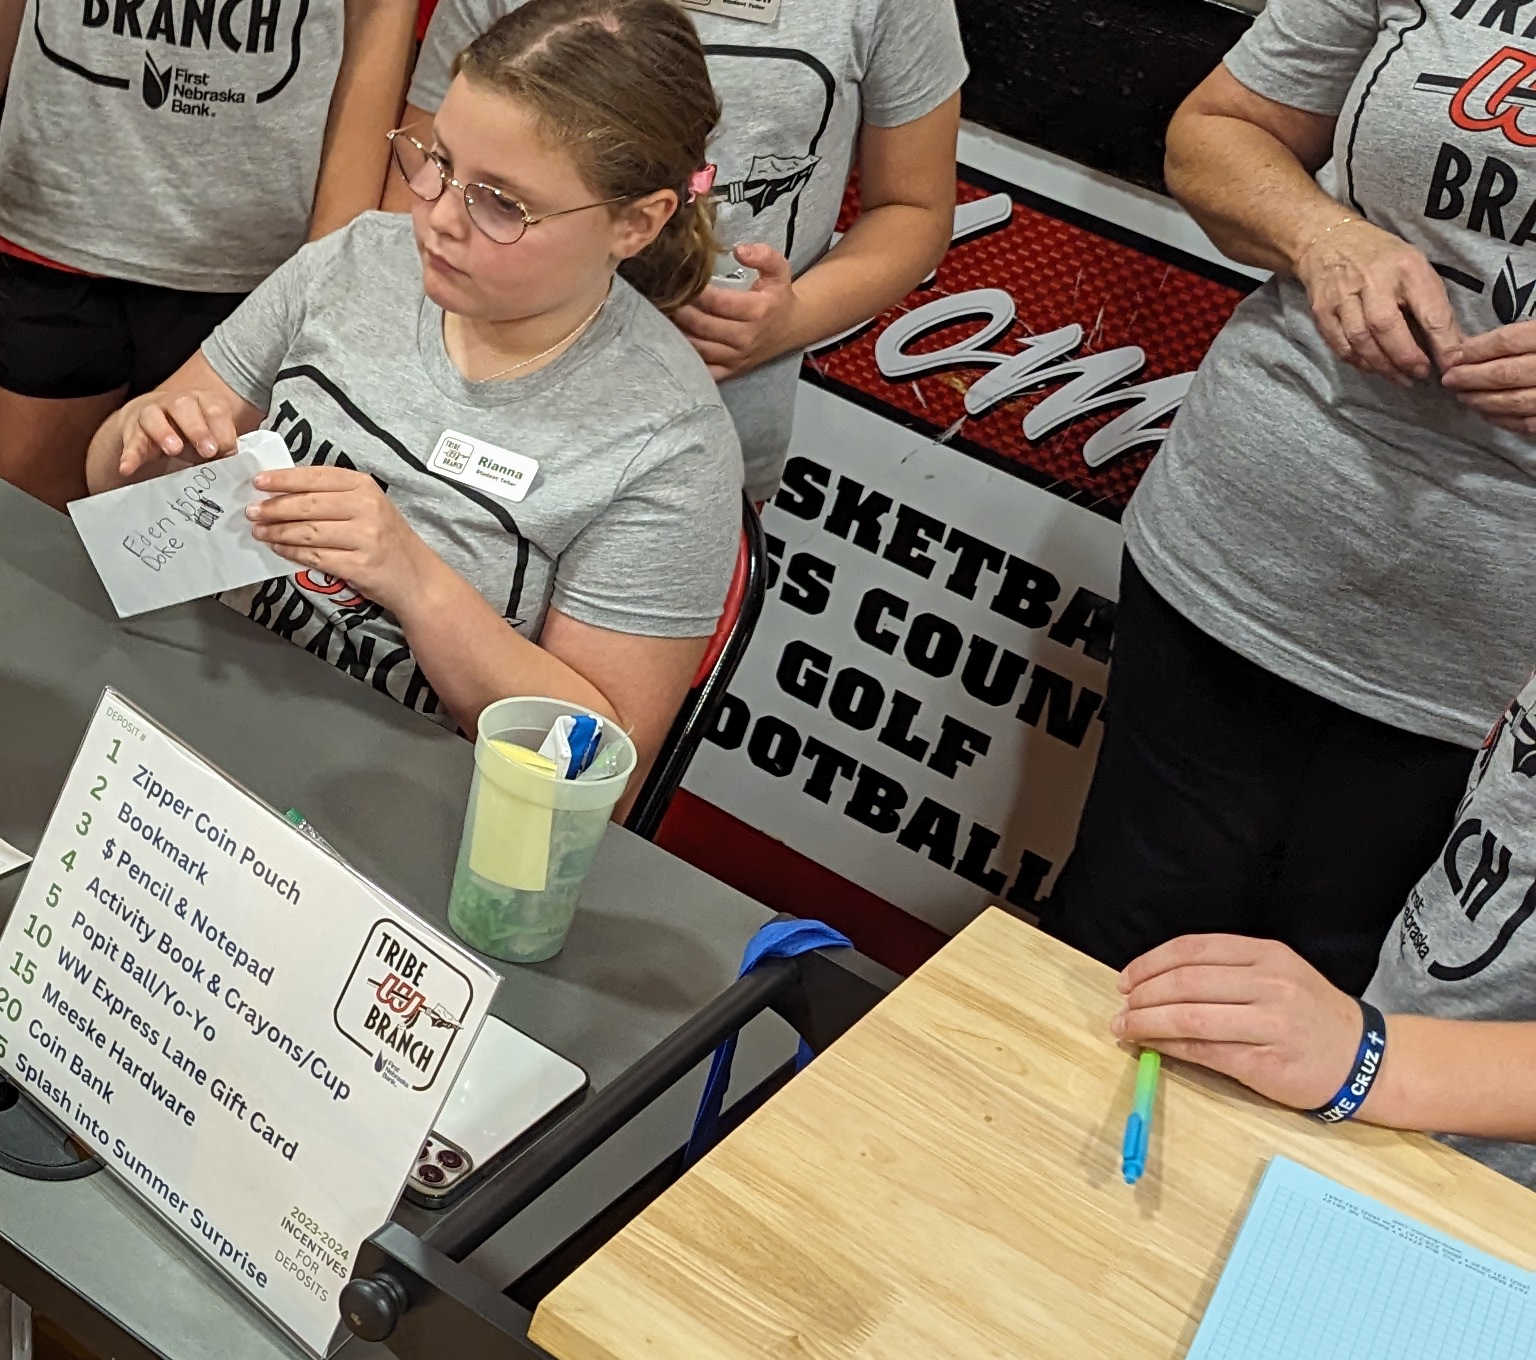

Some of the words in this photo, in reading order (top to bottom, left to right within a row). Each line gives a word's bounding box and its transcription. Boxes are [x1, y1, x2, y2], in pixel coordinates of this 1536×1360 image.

[172, 83, 246, 105] Nebraska
[174, 68, 210, 86] First
[477, 455, 524, 480] Rianna
[122, 517, 175, 558] Eden
[772, 455, 1118, 665] SKETBA
[775, 639, 992, 780] GOLF
[854, 586, 1110, 749] COUN
[106, 706, 140, 738] DEPOSIT
[139, 733, 147, 742] #
[90, 775, 108, 801] 2
[117, 801, 210, 887] Bookmark
[106, 738, 122, 765] 1
[132, 763, 194, 821] Zipper
[195, 812, 237, 857] Coin
[239, 845, 301, 906] Pouch
[701, 690, 1054, 906] OOTBALL
[75, 811, 93, 836] 3
[101, 837, 116, 861] $
[116, 850, 174, 907] Pencil
[174, 896, 189, 920] &
[189, 908, 276, 987] Notepad
[1443, 800, 1514, 922] CH
[45, 882, 63, 908] 5
[70, 910, 120, 962] Popit
[119, 951, 216, 1042] Ball/Yo-Yo
[61, 850, 77, 873] 4
[85, 876, 157, 943] Activity
[156, 931, 207, 984] Book
[206, 973, 223, 998] &
[224, 987, 351, 1101] Crayons/Cup
[375, 931, 429, 988] TRIBE
[9, 951, 38, 985] 15
[41, 981, 106, 1049] Meeske
[107, 1040, 196, 1128] Hardware
[23, 914, 53, 949] 10
[56, 944, 93, 986] WW
[91, 976, 161, 1046] Express
[161, 1036, 207, 1087] Lane
[210, 1078, 248, 1121] Gift
[249, 1111, 299, 1162] Card
[28, 1018, 66, 1064] Coin
[68, 1053, 116, 1106] Bank
[363, 1003, 435, 1074] BRANCH
[1317, 1097, 1356, 1123] LIKE
[1350, 1048, 1380, 1096] CRUZ
[14, 1052, 72, 1114] Splash
[73, 1103, 110, 1146] into
[112, 1138, 190, 1215] Summer
[190, 1207, 269, 1290] Surprise
[274, 1249, 329, 1302] DEPOSITS
[280, 1216, 348, 1279] INCENTIVES
[290, 1206, 351, 1262] 2023-2024
[295, 1248, 320, 1275] FOR
